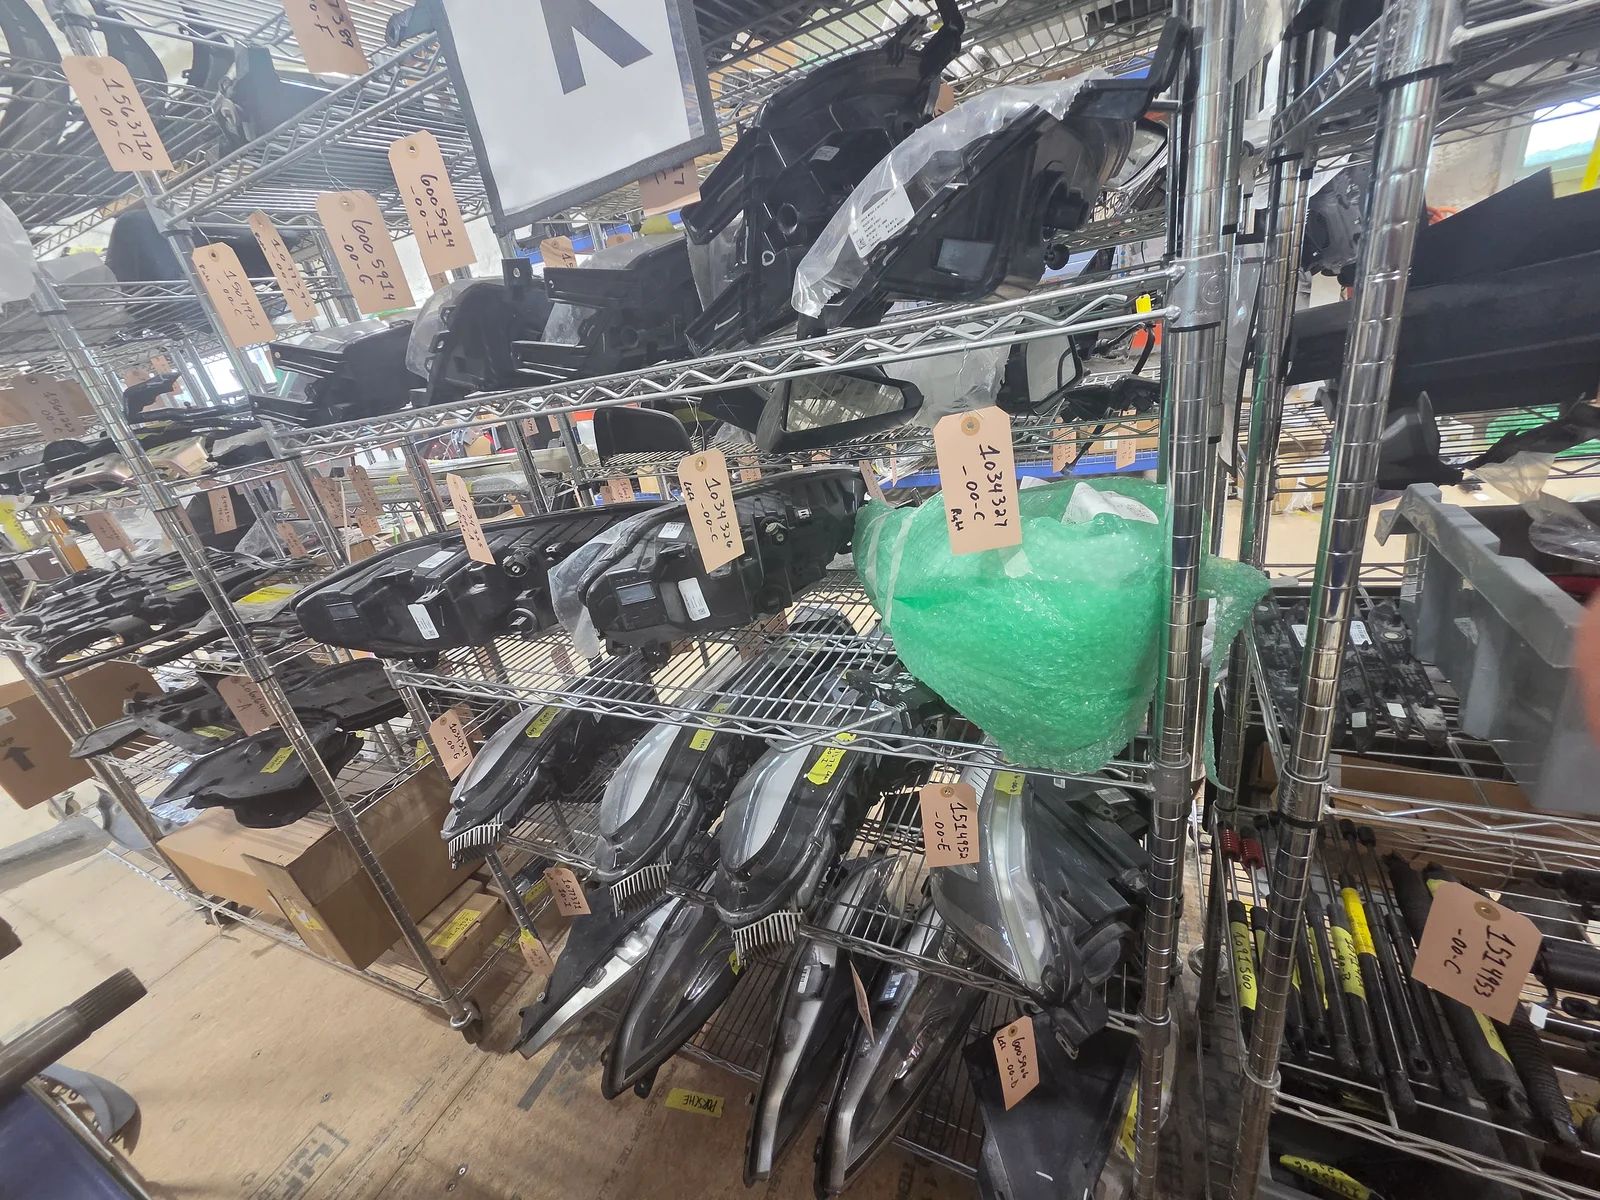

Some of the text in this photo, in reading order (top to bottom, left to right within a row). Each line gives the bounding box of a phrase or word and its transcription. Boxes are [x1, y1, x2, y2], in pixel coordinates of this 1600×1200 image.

[102, 77, 153, 161] 1563710
[704, 477, 733, 548] 1034326
[979, 444, 1008, 527] 1034327
[949, 802, 969, 860] 1514952
[1232, 931, 1253, 990] 1091560
[1473, 925, 1517, 998] 1514953
